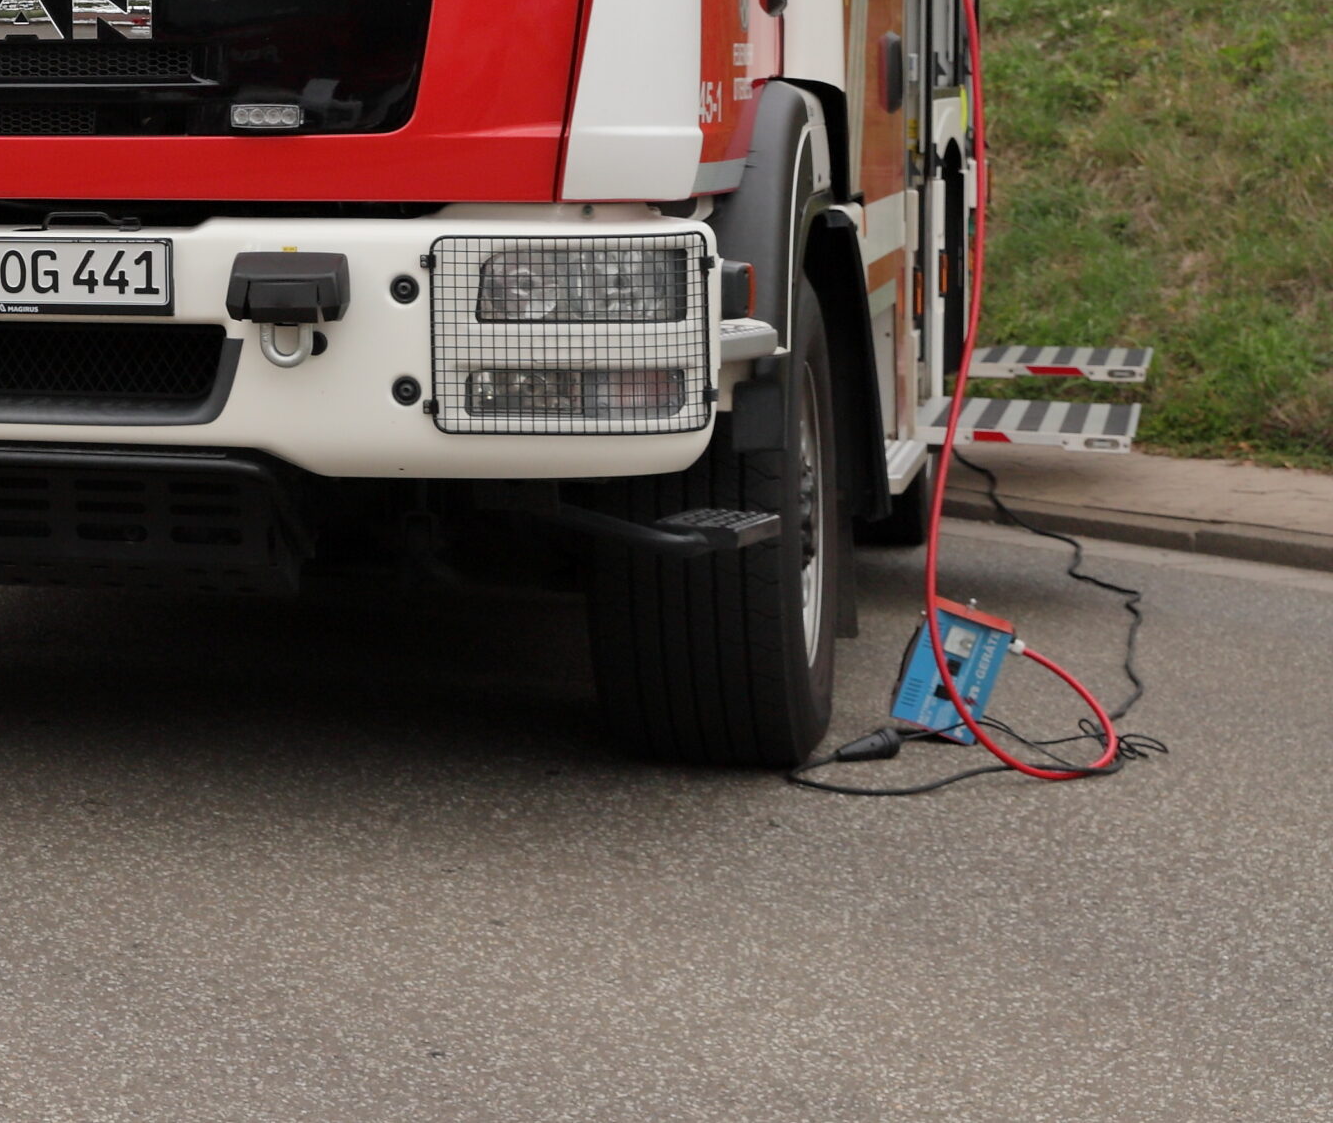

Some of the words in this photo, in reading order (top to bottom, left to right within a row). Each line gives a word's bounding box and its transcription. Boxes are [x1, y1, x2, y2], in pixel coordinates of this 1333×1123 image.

[0, 249, 59, 294] OG
[72, 250, 160, 295] 441
[7, 305, 39, 313] MAGIRUS
